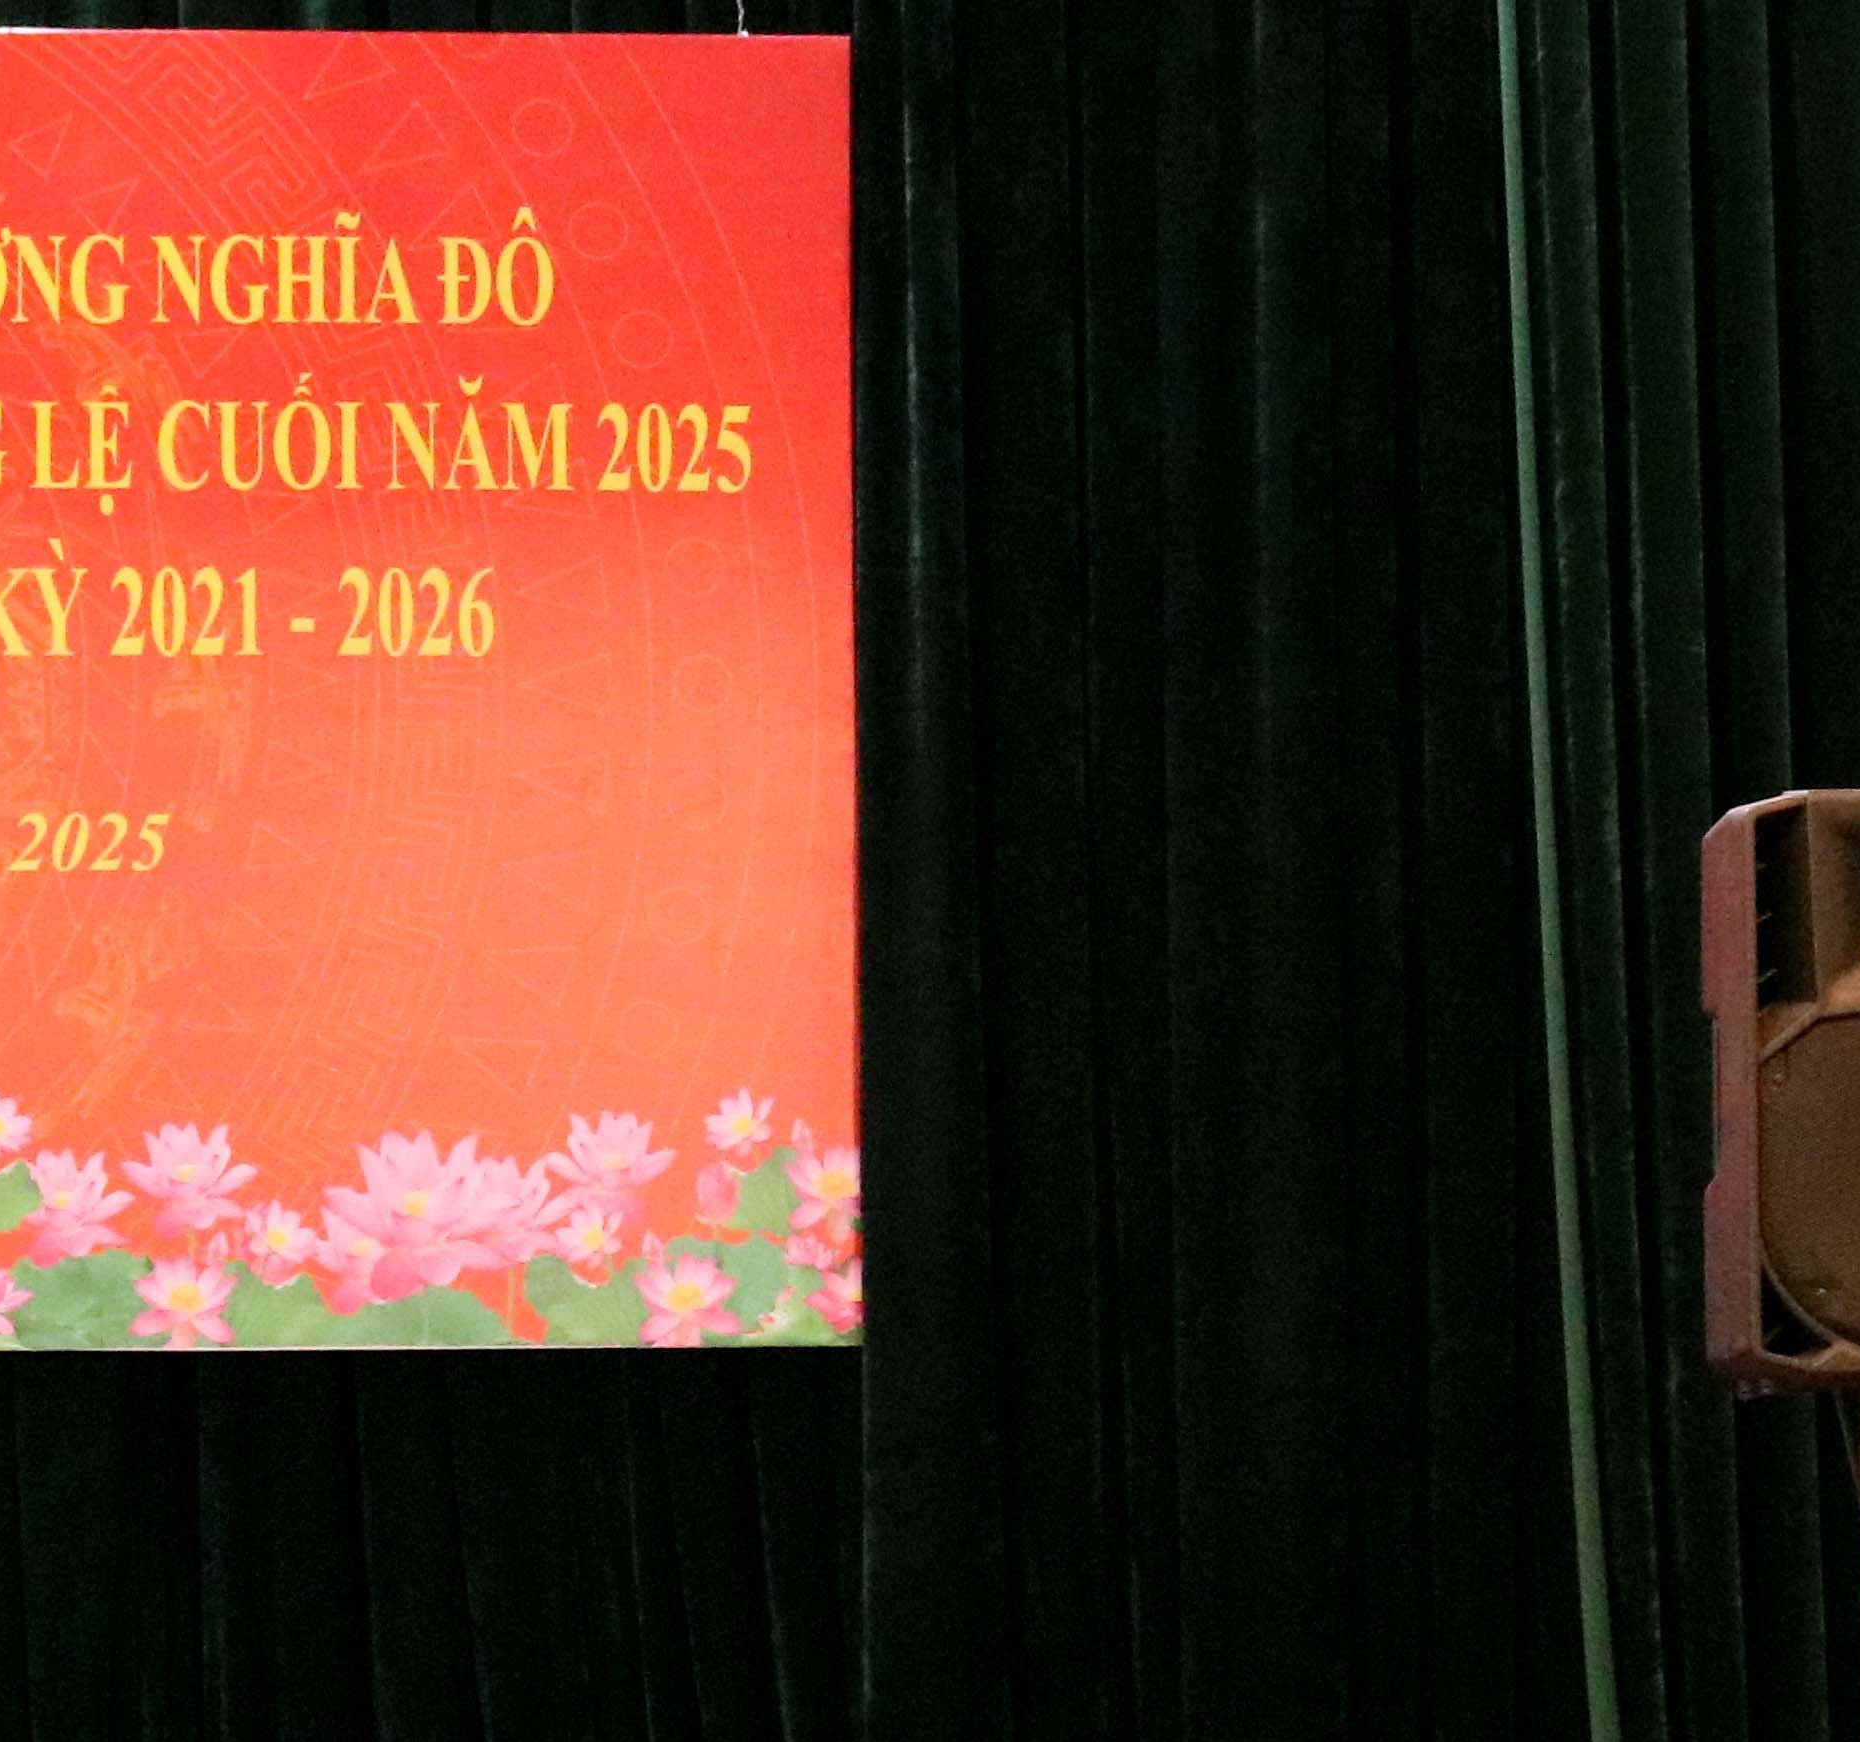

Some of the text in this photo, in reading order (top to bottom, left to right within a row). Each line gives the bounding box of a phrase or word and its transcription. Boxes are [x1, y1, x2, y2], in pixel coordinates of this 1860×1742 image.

[151, 208, 420, 325] NGHĨA
[437, 206, 554, 326] ĐÔ
[31, 384, 132, 516] LỆ
[157, 372, 362, 491] CUỐI
[385, 376, 573, 491] NĂM
[597, 403, 752, 493] 2025
[110, 566, 262, 658] 2021
[290, 617, 315, 633] -
[339, 567, 495, 658] 2026
[8, 812, 169, 871] 2025
